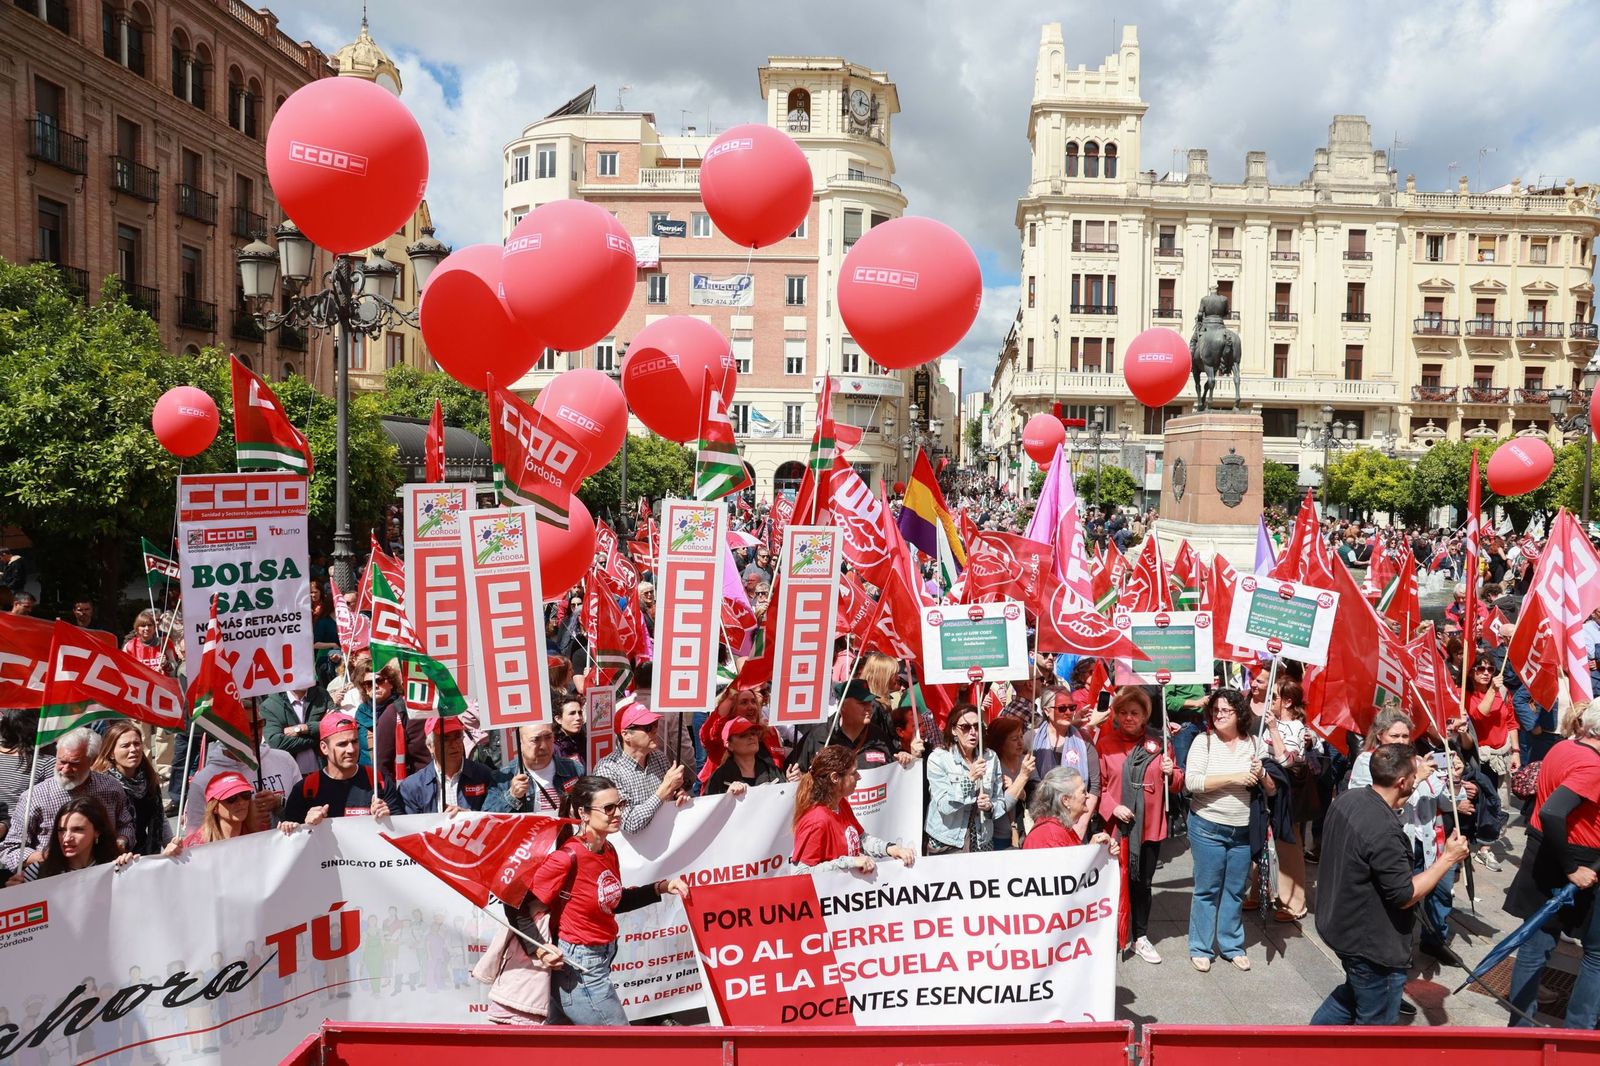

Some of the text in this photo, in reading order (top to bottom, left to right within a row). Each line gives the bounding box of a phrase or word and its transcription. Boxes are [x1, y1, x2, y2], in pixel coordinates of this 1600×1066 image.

[291, 145, 347, 168] CCOO
[707, 140, 740, 160] CCOO
[856, 268, 899, 285] CCOO
[631, 359, 669, 377] CCOO
[1138, 354, 1166, 362] CCOO
[178, 406, 205, 418] CCOO
[559, 406, 595, 431] CCOO
[500, 400, 578, 475] CCOO
[181, 481, 306, 510] CCOO
[207, 530, 245, 541] CCOO
[191, 557, 302, 588] BOLSA
[209, 588, 274, 615] SAS
[218, 617, 243, 631] MÁS
[245, 611, 302, 627] RETRASOS
[222, 626, 276, 642] BLOQUEO
[278, 624, 301, 635] VEC
[668, 569, 705, 700] CCOO
[487, 581, 532, 715] CCOO
[786, 591, 822, 713] CCOO
[54, 645, 182, 719] CCOO
[320, 858, 419, 869] SINDICATO DE SAN
[681, 854, 784, 887] MOMENTO
[703, 868, 1099, 932] POR UNA ENSEÑANZA DE CALIDAD
[13, 923, 49, 936] sectores
[265, 901, 361, 978] TÚ
[624, 924, 690, 943] PROFESIO
[700, 897, 1113, 969] NO AL CIERRE DE UNIDADES
[648, 950, 697, 967] SISTEM
[725, 937, 1093, 1001] DE LA ESCUELA PÚBLICA
[623, 976, 663, 988] espera
[634, 993, 650, 1004] LA
[781, 980, 1054, 1024] DOCENTES ESENCIALES
